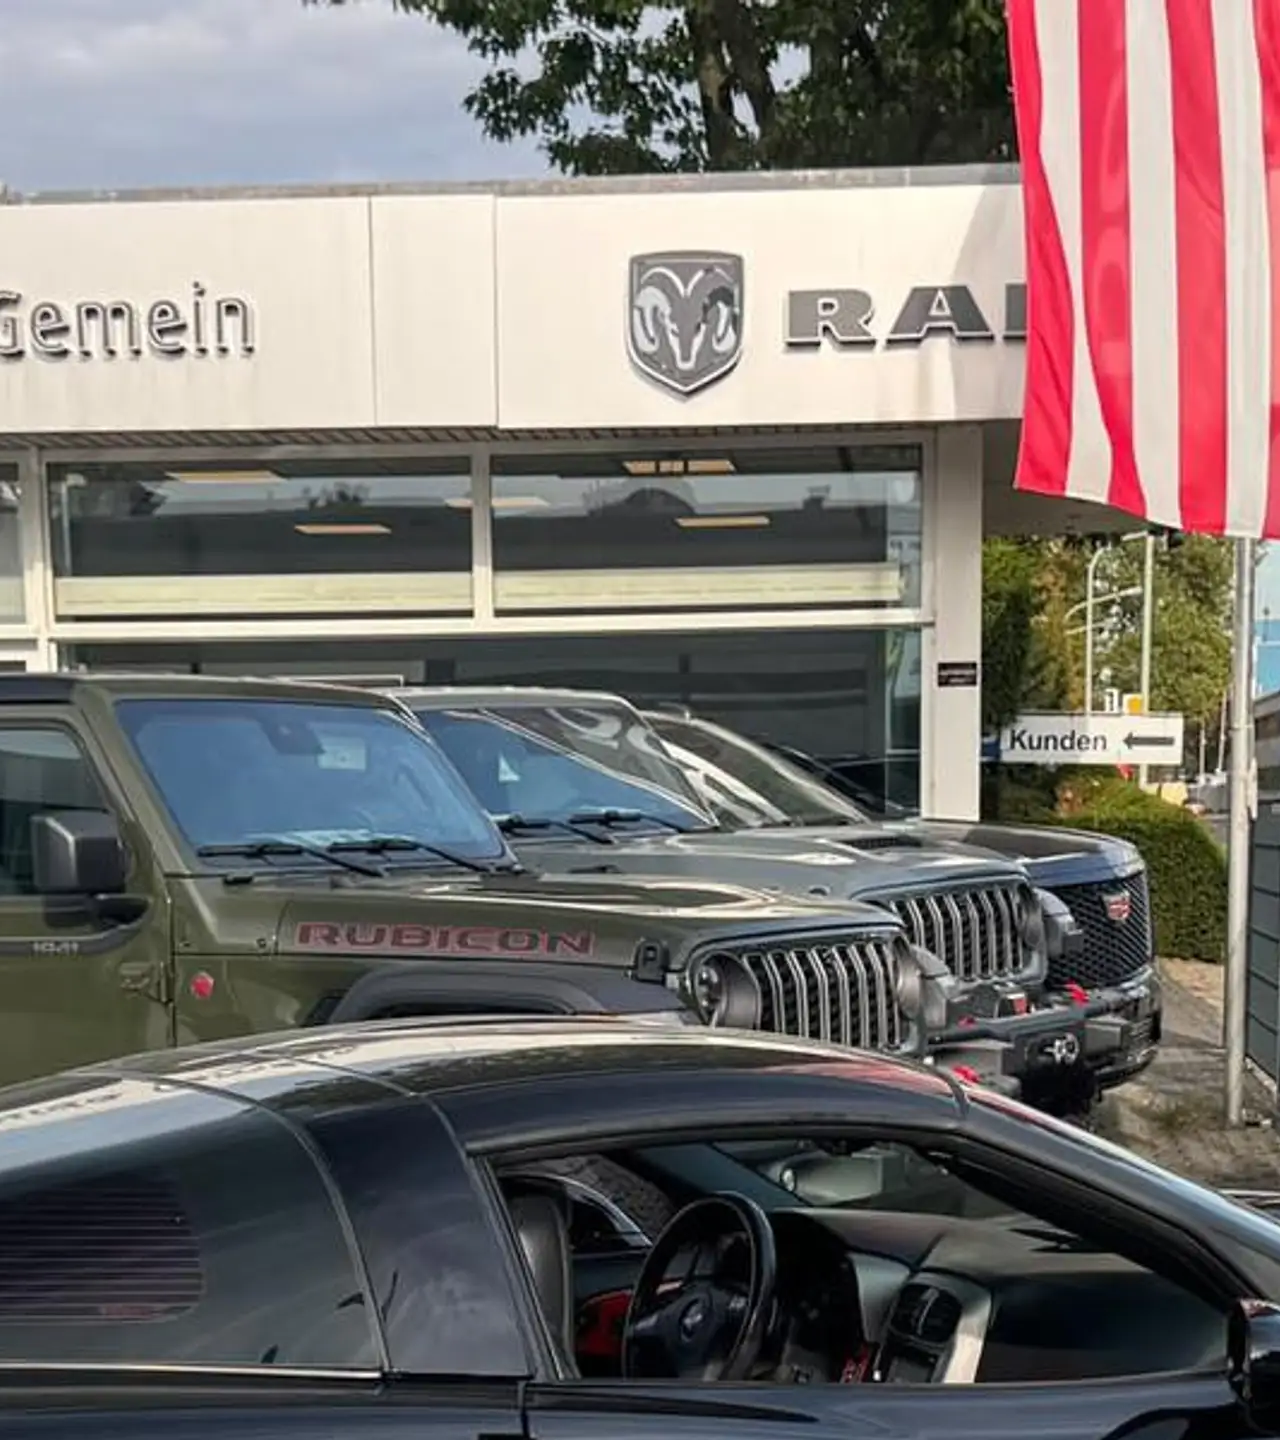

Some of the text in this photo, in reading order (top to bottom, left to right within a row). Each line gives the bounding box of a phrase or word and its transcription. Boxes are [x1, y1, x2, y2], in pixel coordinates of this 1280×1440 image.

[786, 284, 1028, 347] RA
[1009, 730, 1108, 751] Kunden
[296, 921, 597, 955] RUBICON
